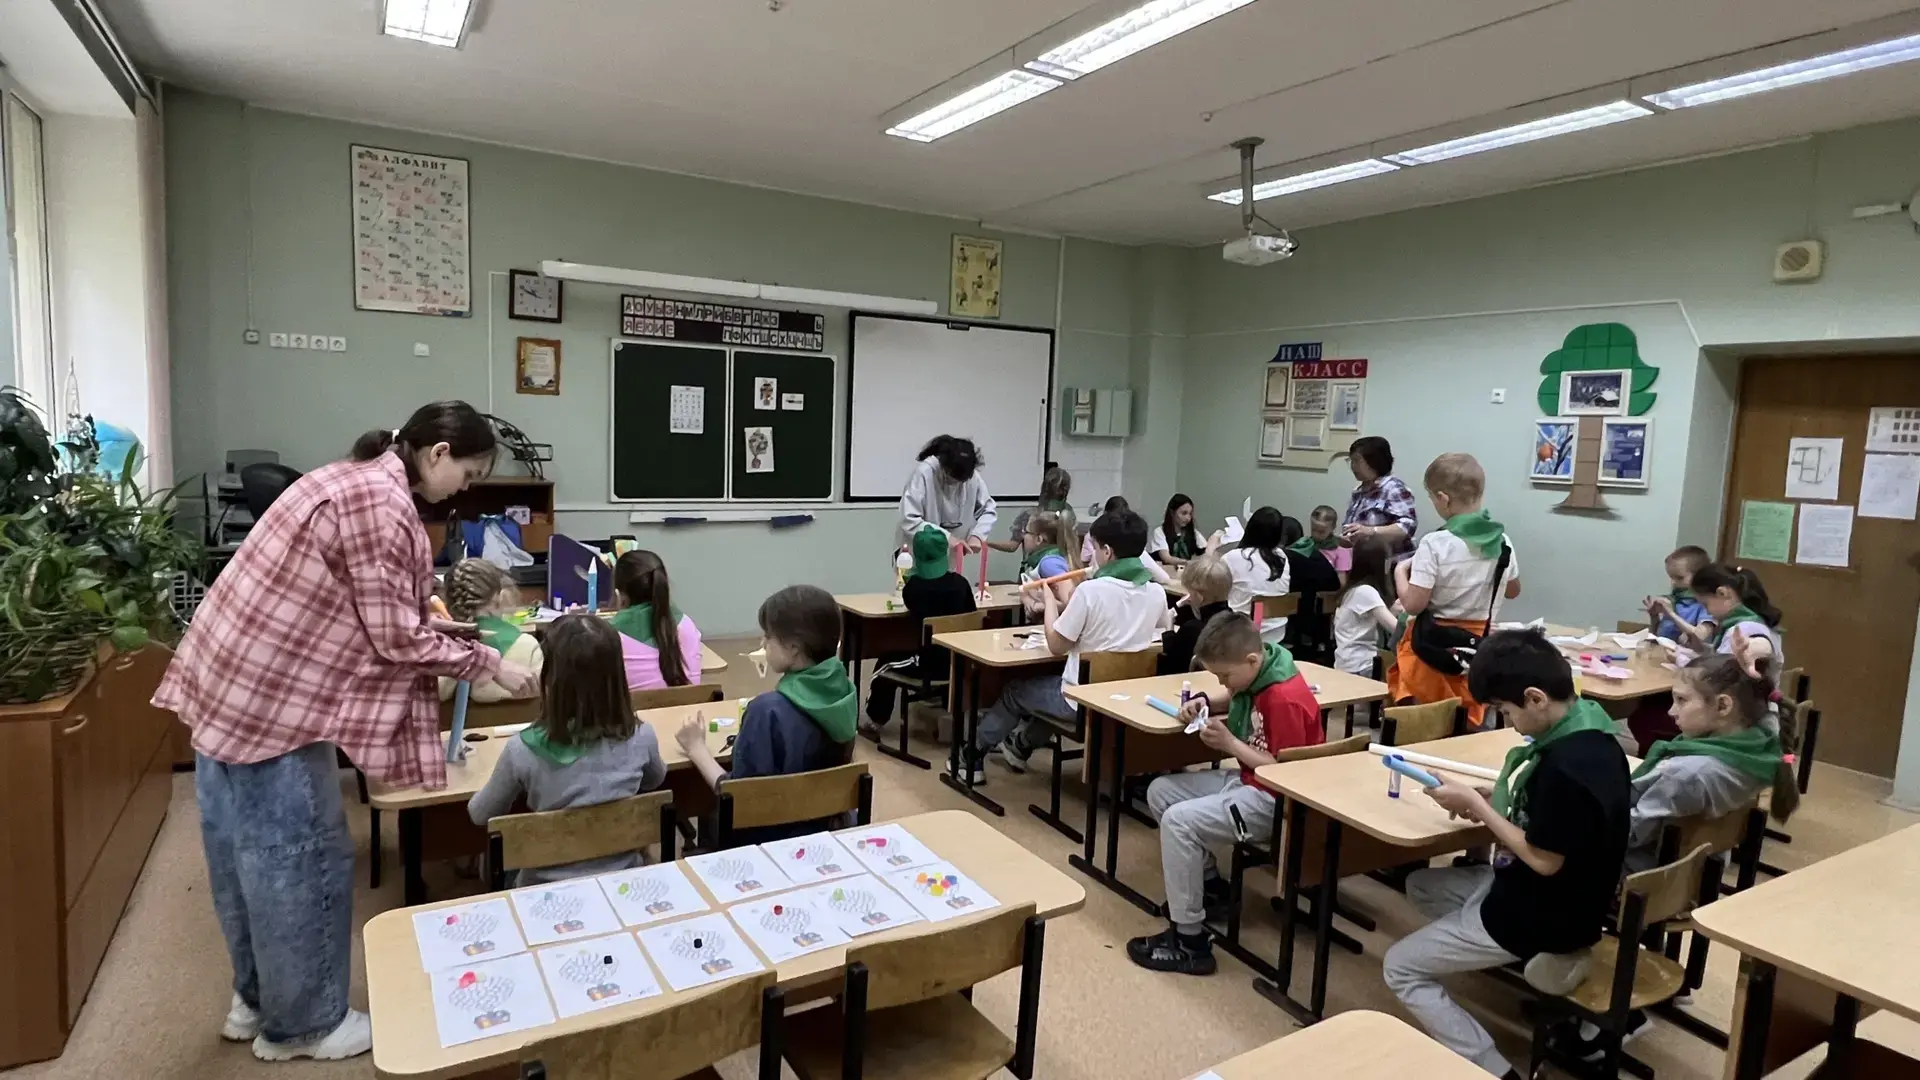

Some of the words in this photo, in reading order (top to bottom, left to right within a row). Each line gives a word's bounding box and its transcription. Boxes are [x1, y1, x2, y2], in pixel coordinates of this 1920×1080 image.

[382, 154, 447, 171] АЛФАВИТ
[1280, 344, 1321, 360] НАШ
[1293, 361, 1362, 377] КЛАСС
